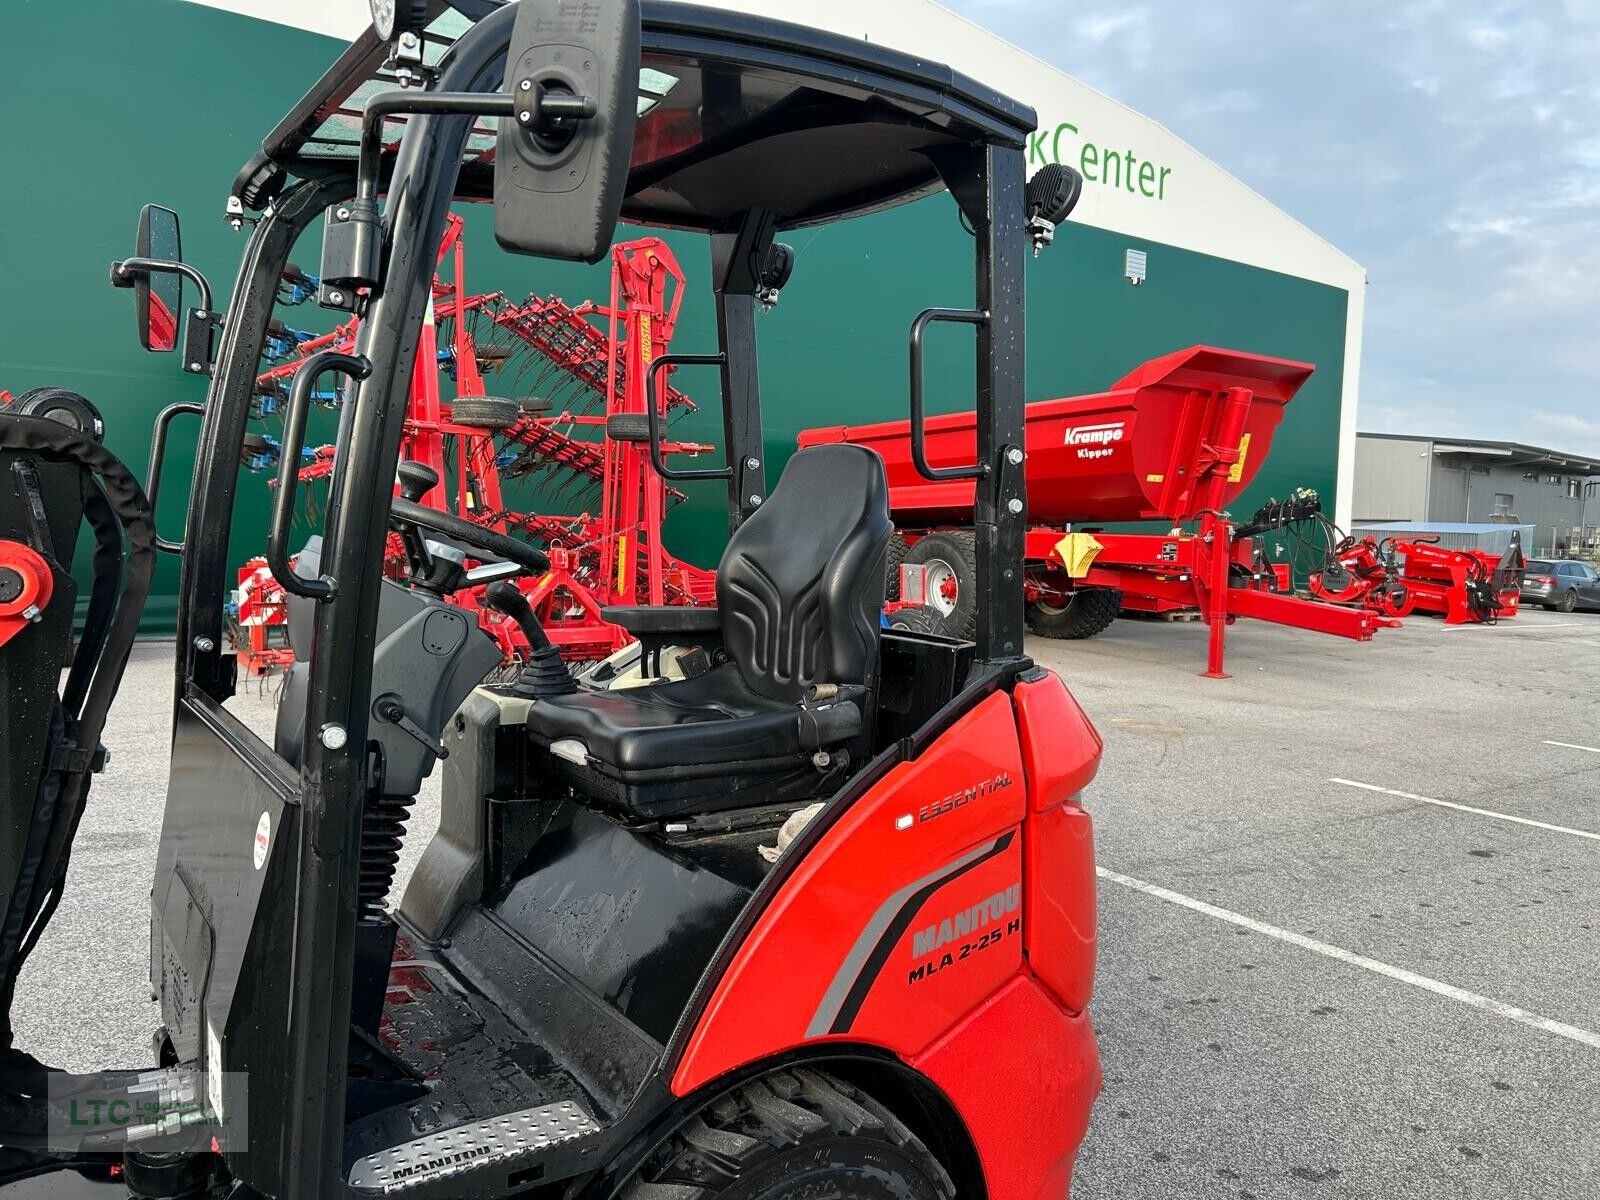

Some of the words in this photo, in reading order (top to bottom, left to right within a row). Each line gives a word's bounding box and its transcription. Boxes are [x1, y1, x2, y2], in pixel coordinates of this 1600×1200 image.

[641, 314, 652, 365] AEROSTAR
[1064, 422, 1125, 445] Krampe
[1077, 448, 1113, 459] Kipper
[919, 772, 1013, 823] ESSENTIAL
[912, 883, 1020, 960] MANITOU
[909, 953, 954, 985] MLA
[958, 928, 1003, 961] 2-25
[1007, 918, 1020, 936] H
[392, 1146, 491, 1180] MANITOU
